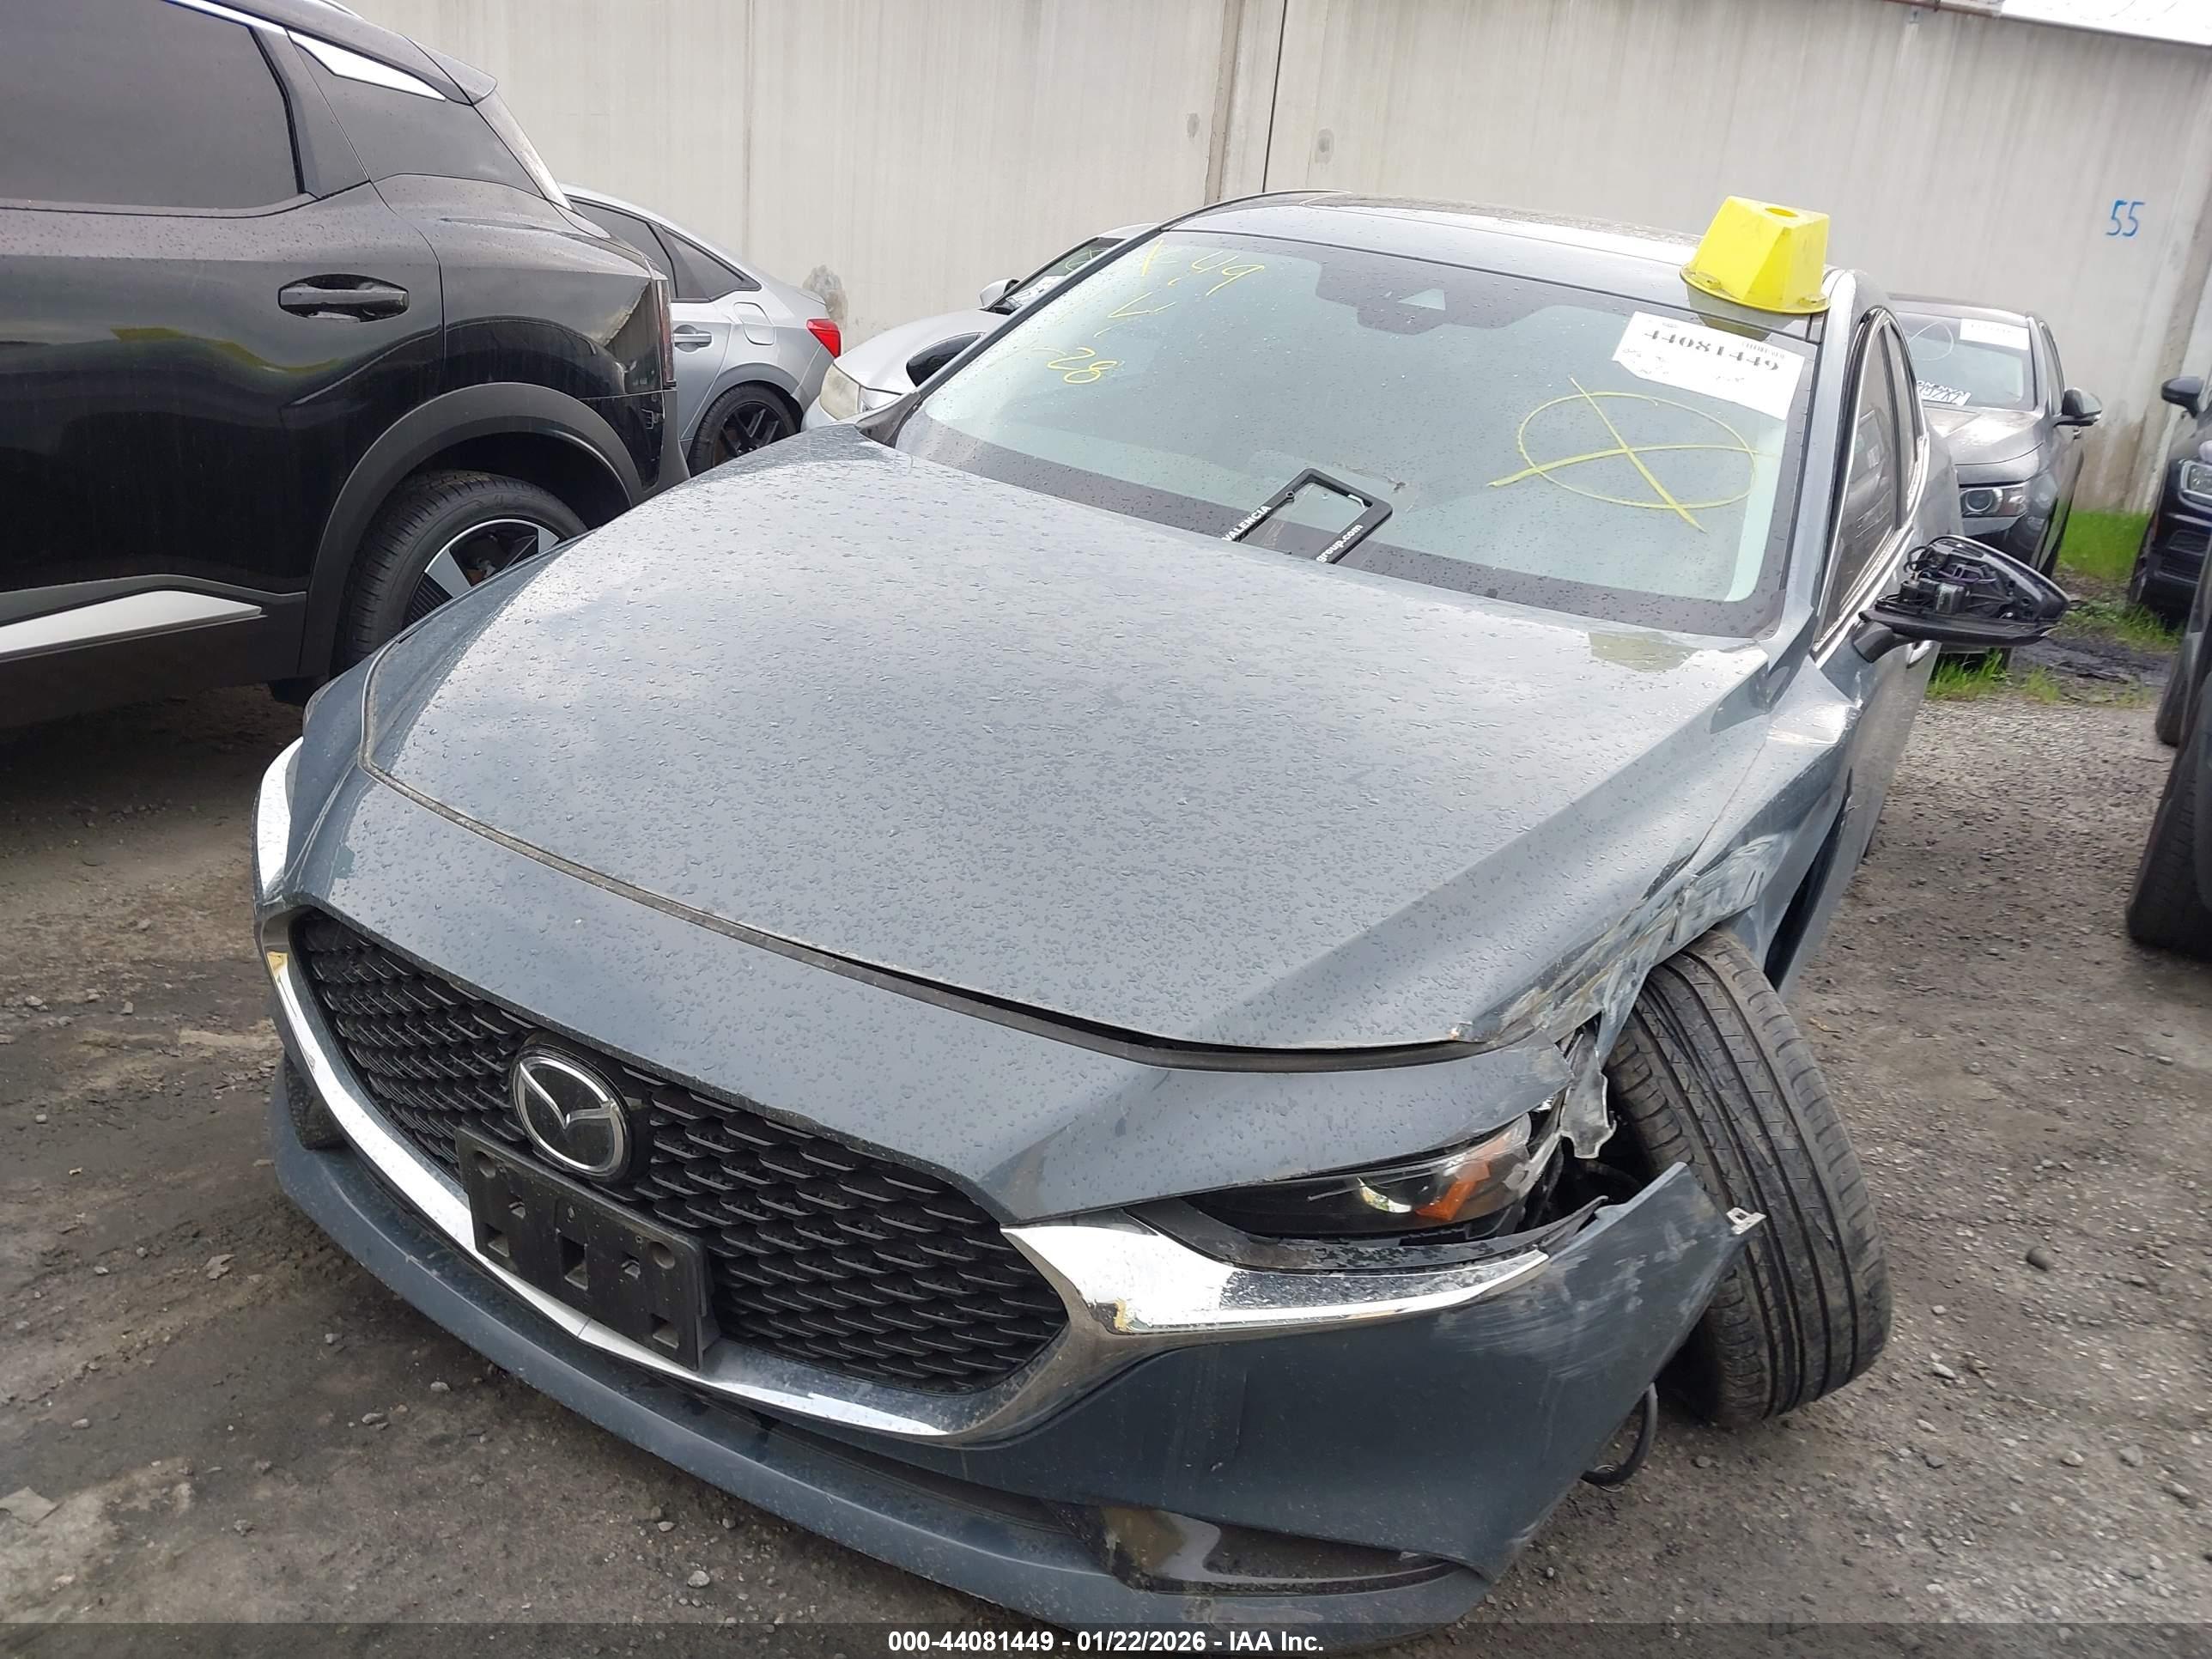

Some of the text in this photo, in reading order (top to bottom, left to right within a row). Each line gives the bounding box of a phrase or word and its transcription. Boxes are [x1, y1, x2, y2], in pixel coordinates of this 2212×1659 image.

[2105, 200, 2146, 237] 55
[1221, 505, 1272, 541] VALENCIA
[1316, 524, 1364, 563] group.com
